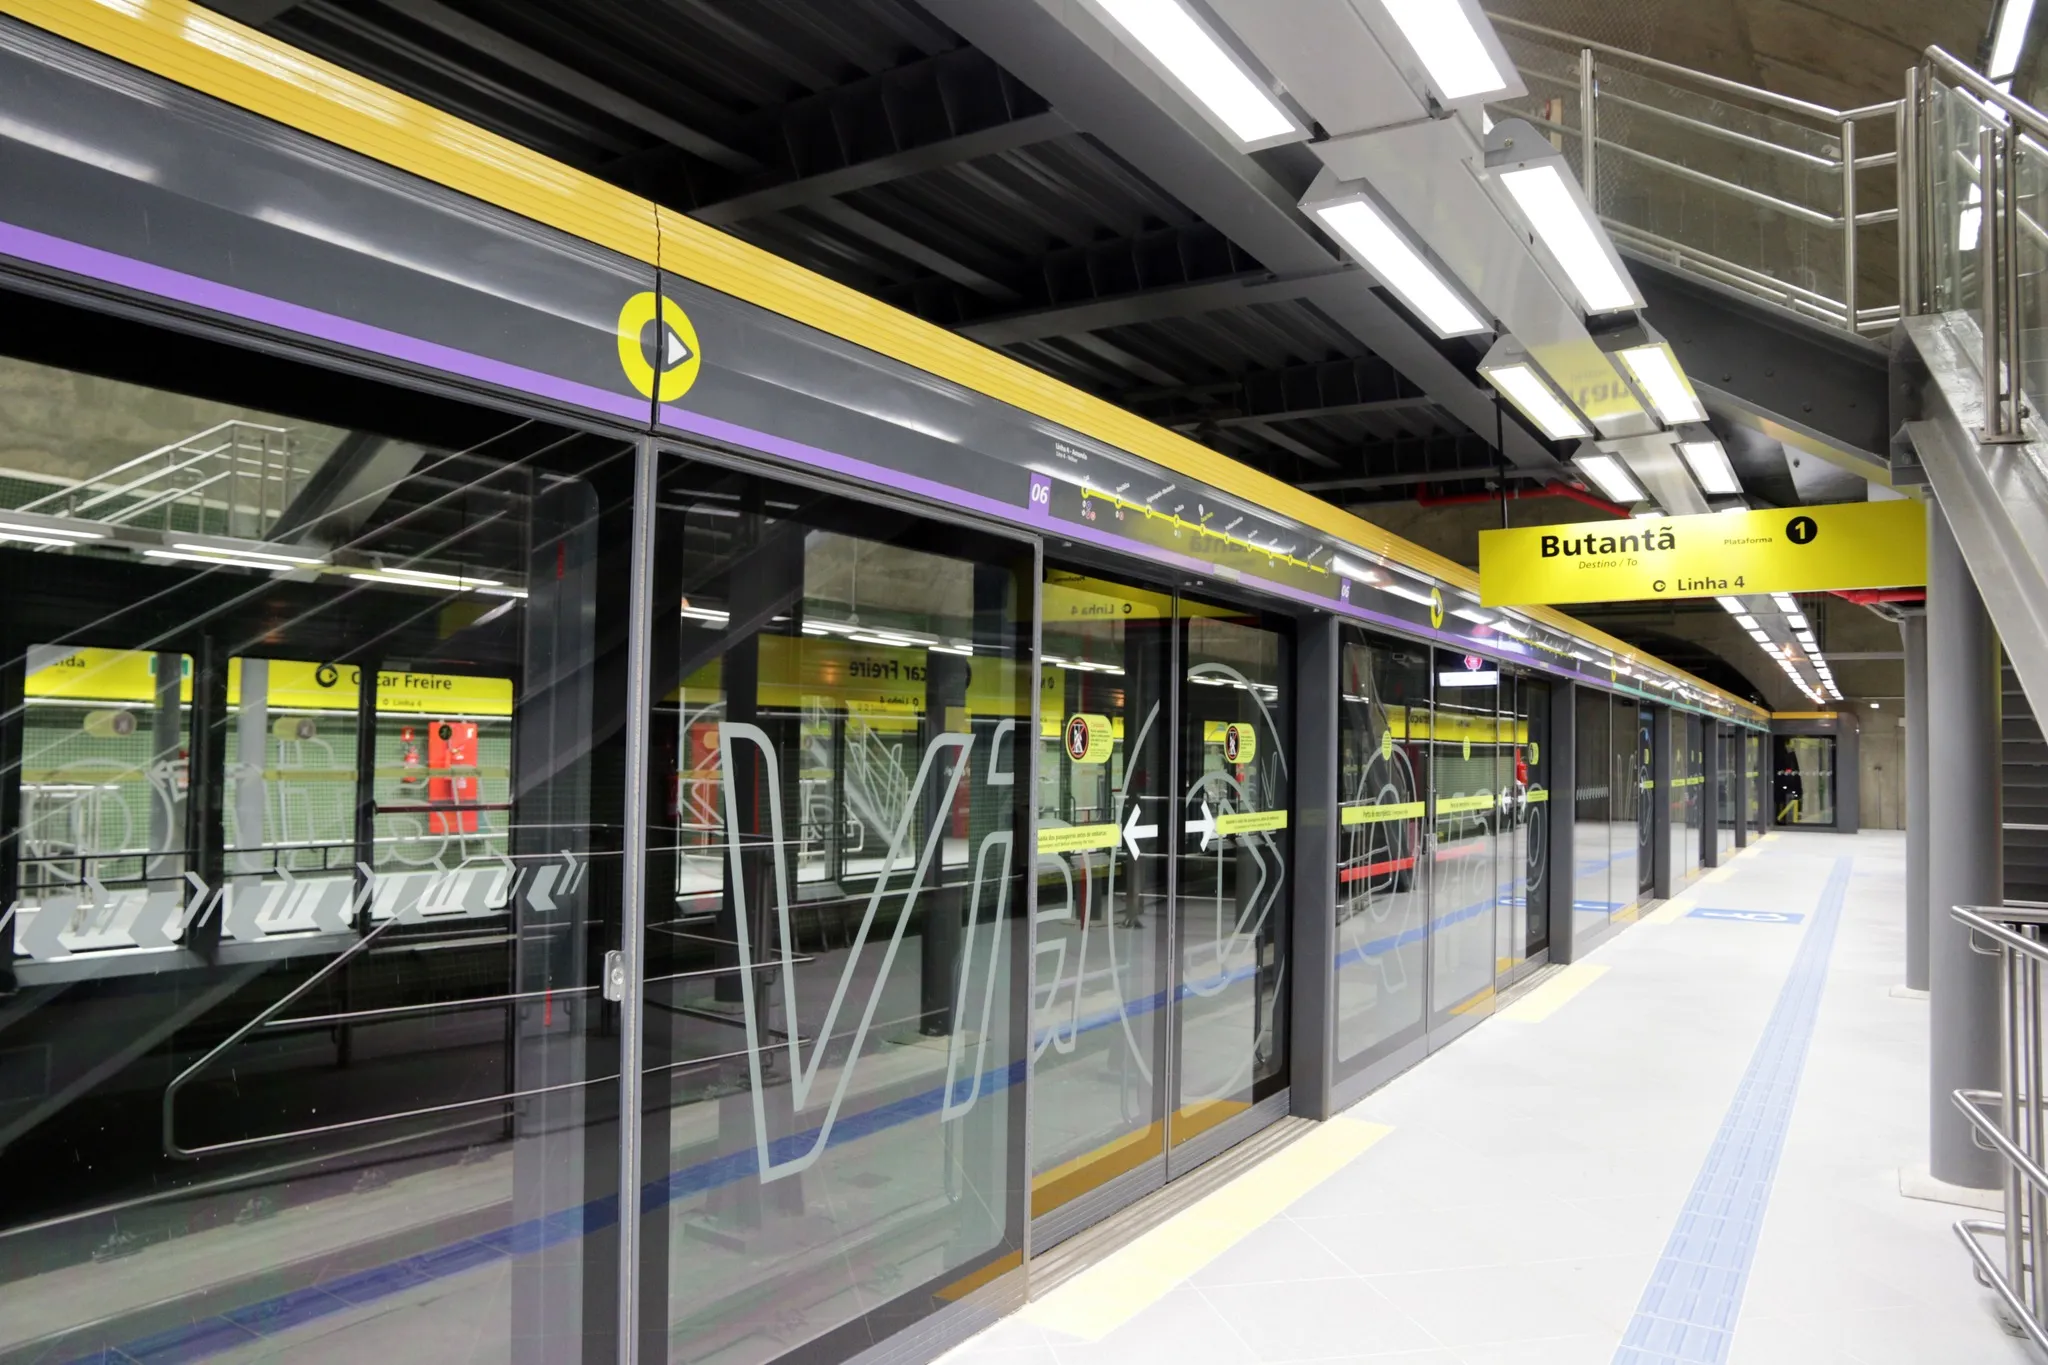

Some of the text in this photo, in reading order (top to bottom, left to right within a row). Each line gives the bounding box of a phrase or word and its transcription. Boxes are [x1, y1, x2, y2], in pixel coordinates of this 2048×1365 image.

[1032, 482, 1049, 505] 06
[1541, 525, 1676, 558] Butantã
[1723, 522, 1807, 546] Plataforma 1
[1578, 559, 1617, 570] Destino
[1626, 558, 1638, 567] To
[1341, 583, 1350, 598] 06
[1678, 575, 1745, 592] Linha 4
[351, 671, 452, 689] Ocar Freire
